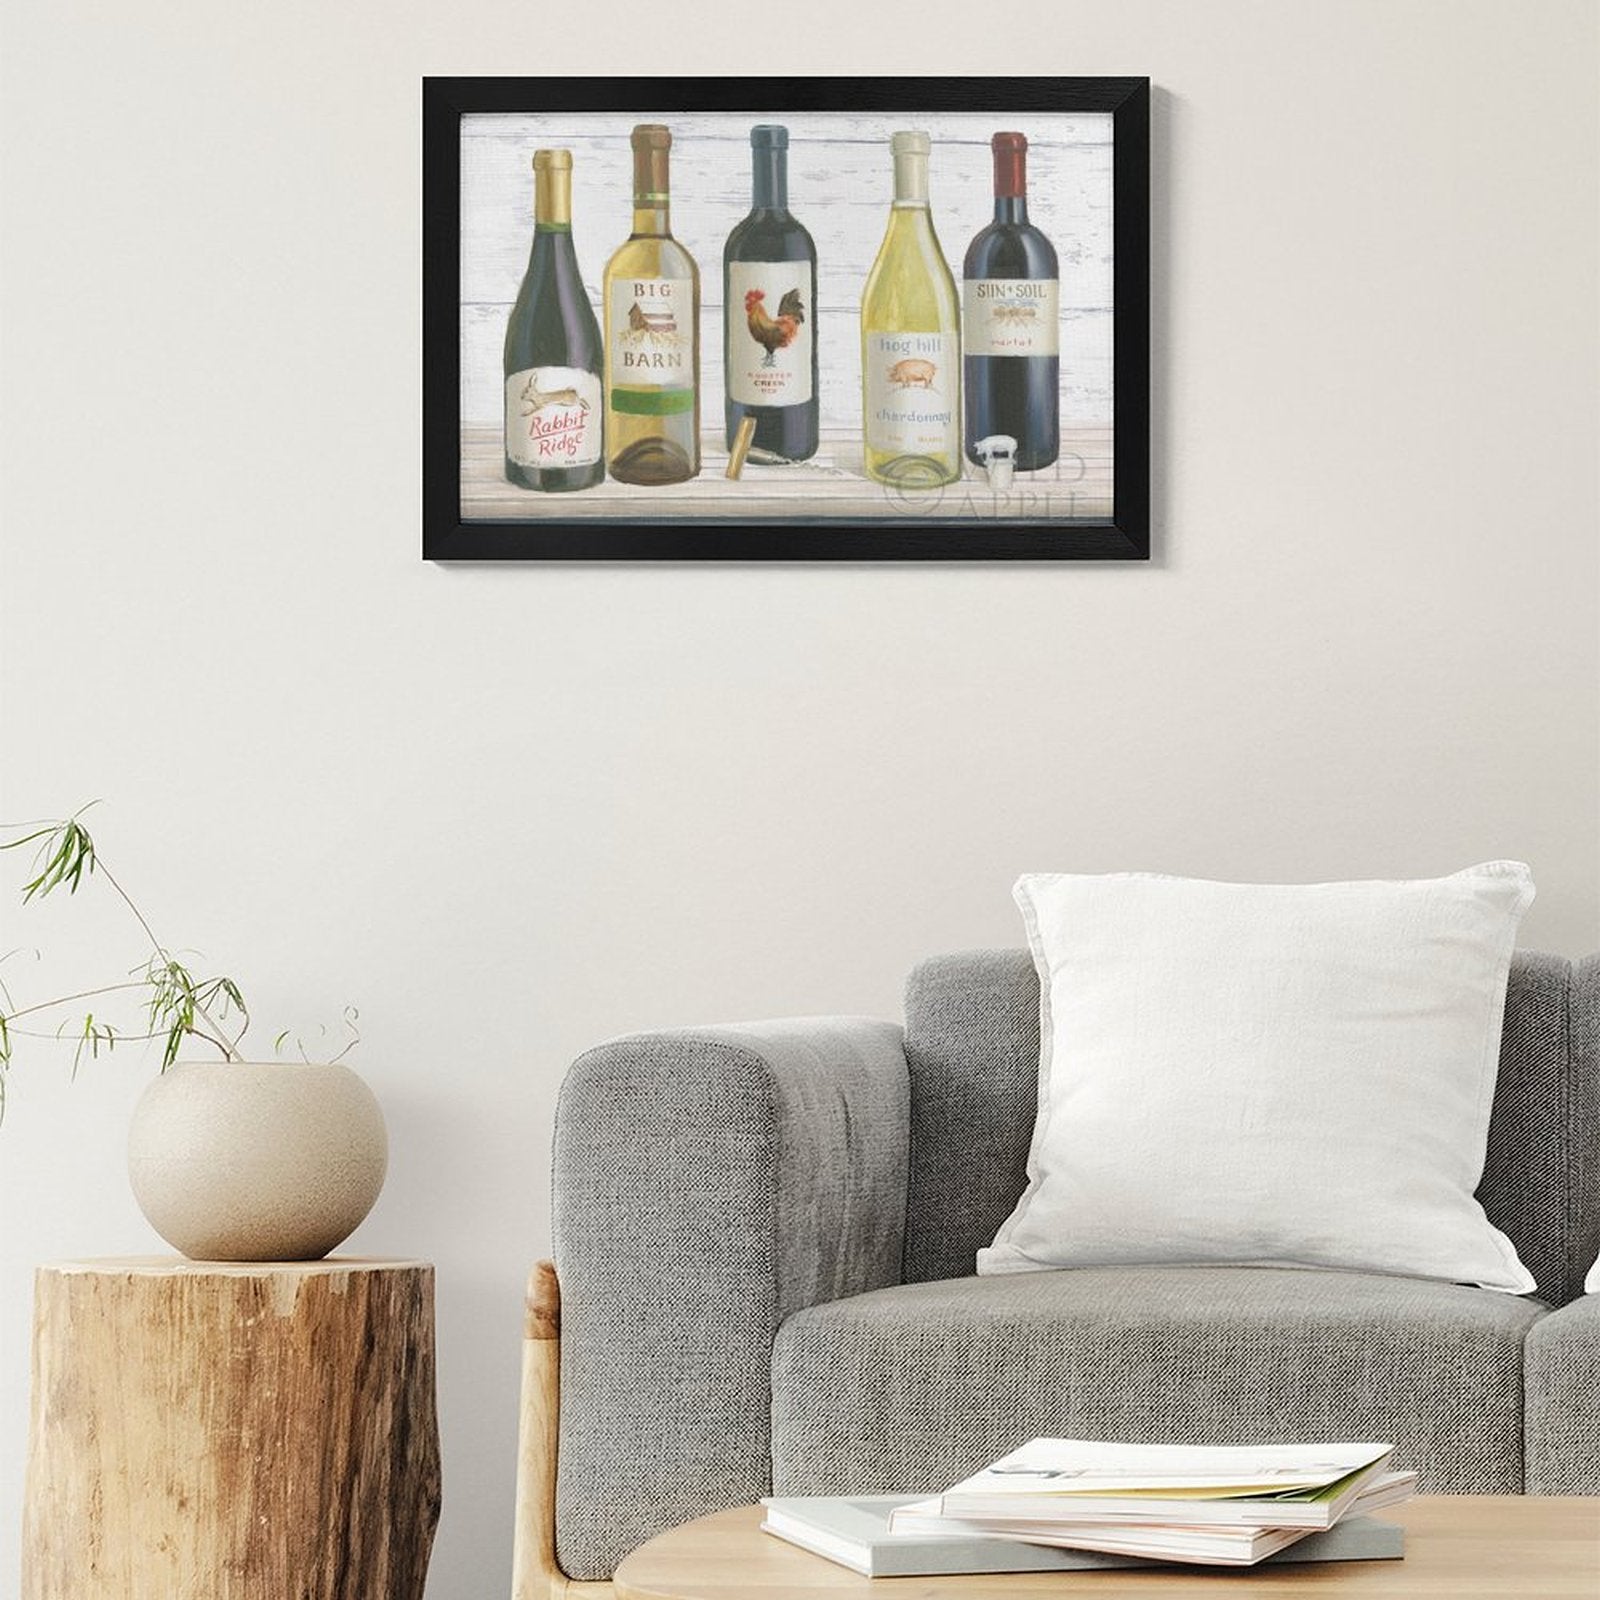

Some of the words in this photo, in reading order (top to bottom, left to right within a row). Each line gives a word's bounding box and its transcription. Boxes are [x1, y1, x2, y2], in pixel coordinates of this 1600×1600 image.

[633, 283, 671, 297] BIG
[880, 338, 911, 356] hog
[916, 338, 941, 353] hill
[623, 352, 682, 368] BARN
[528, 409, 589, 437] Rabbit
[876, 408, 952, 427] chardonnay
[539, 431, 583, 457] Ridge
